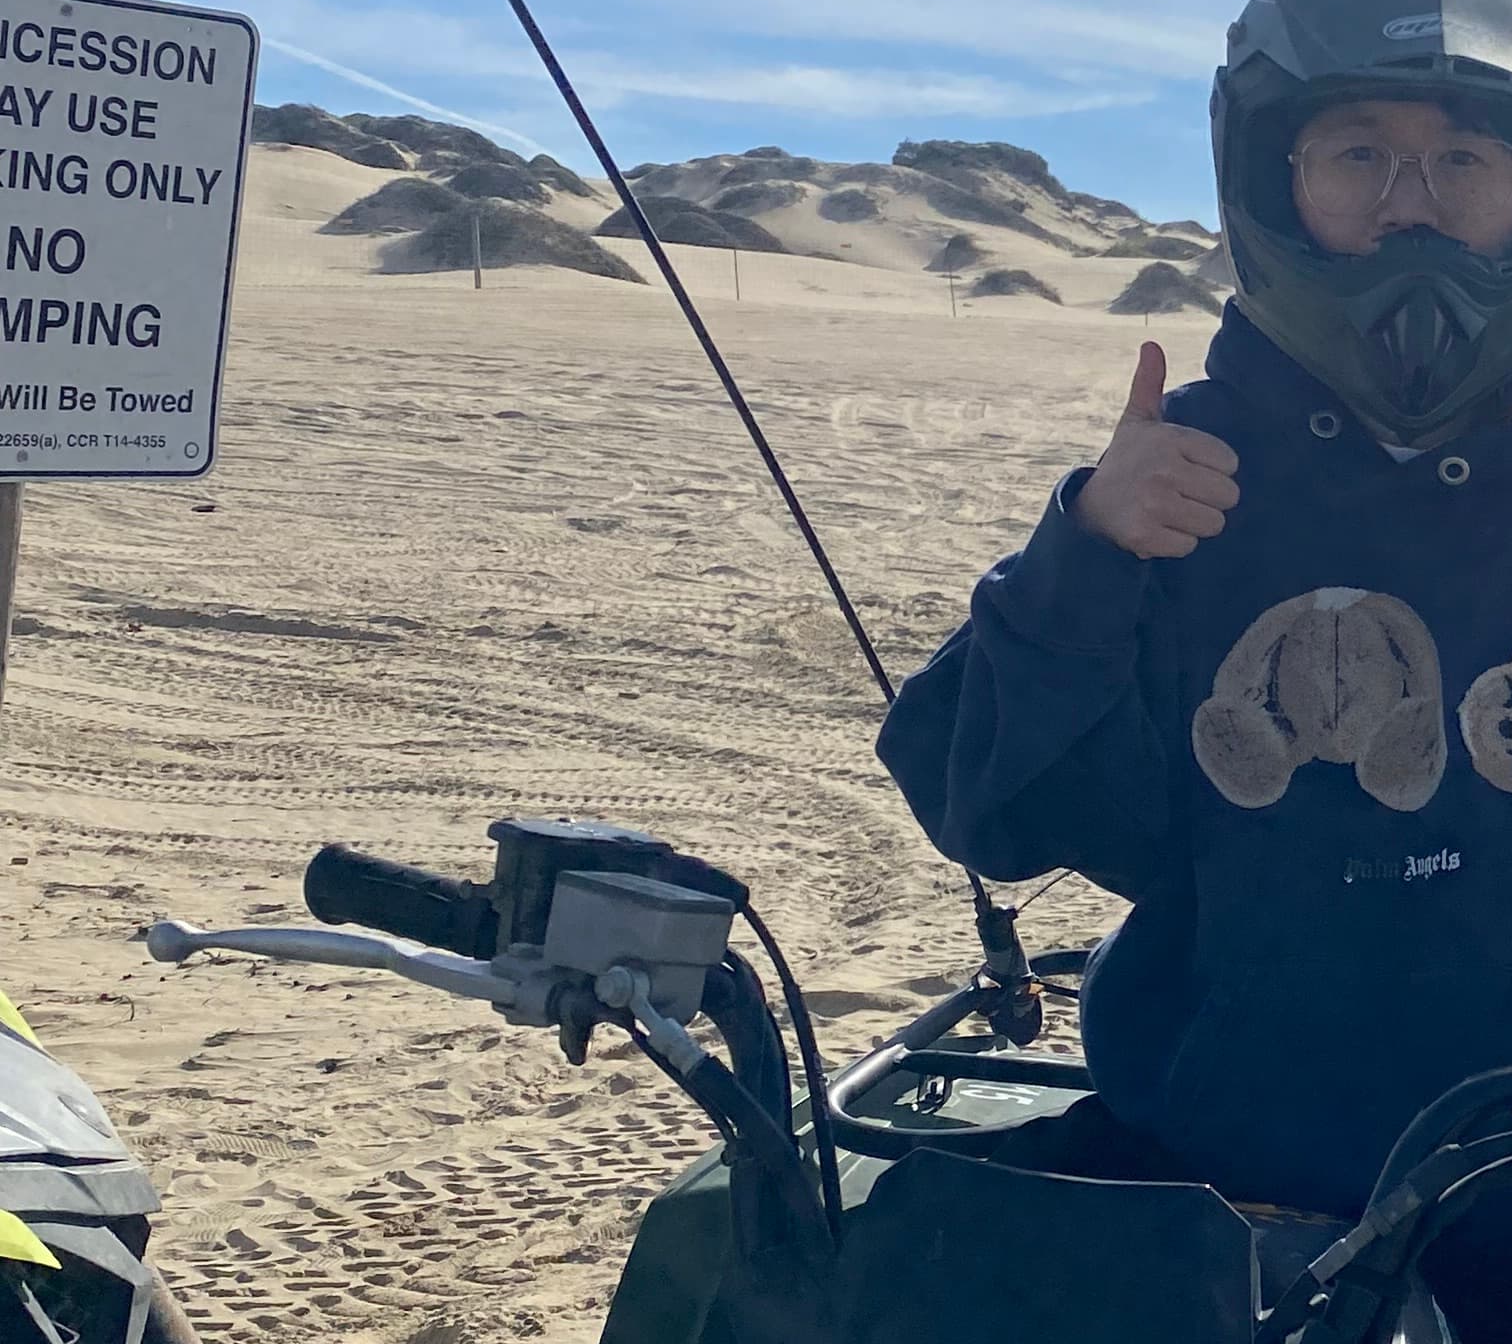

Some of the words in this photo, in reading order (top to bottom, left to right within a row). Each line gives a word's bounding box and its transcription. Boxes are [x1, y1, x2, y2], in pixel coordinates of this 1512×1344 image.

[1, 19, 216, 85] CESSION
[68, 93, 158, 139] USE
[105, 159, 222, 205] ONLY
[6, 226, 86, 274] NO
[0, 385, 48, 411] Will
[58, 386, 97, 411] Be
[105, 387, 194, 414] Towed
[66, 434, 99, 447] CCR
[103, 435, 167, 449] T14-4355
[1403, 847, 1461, 881] Angels
